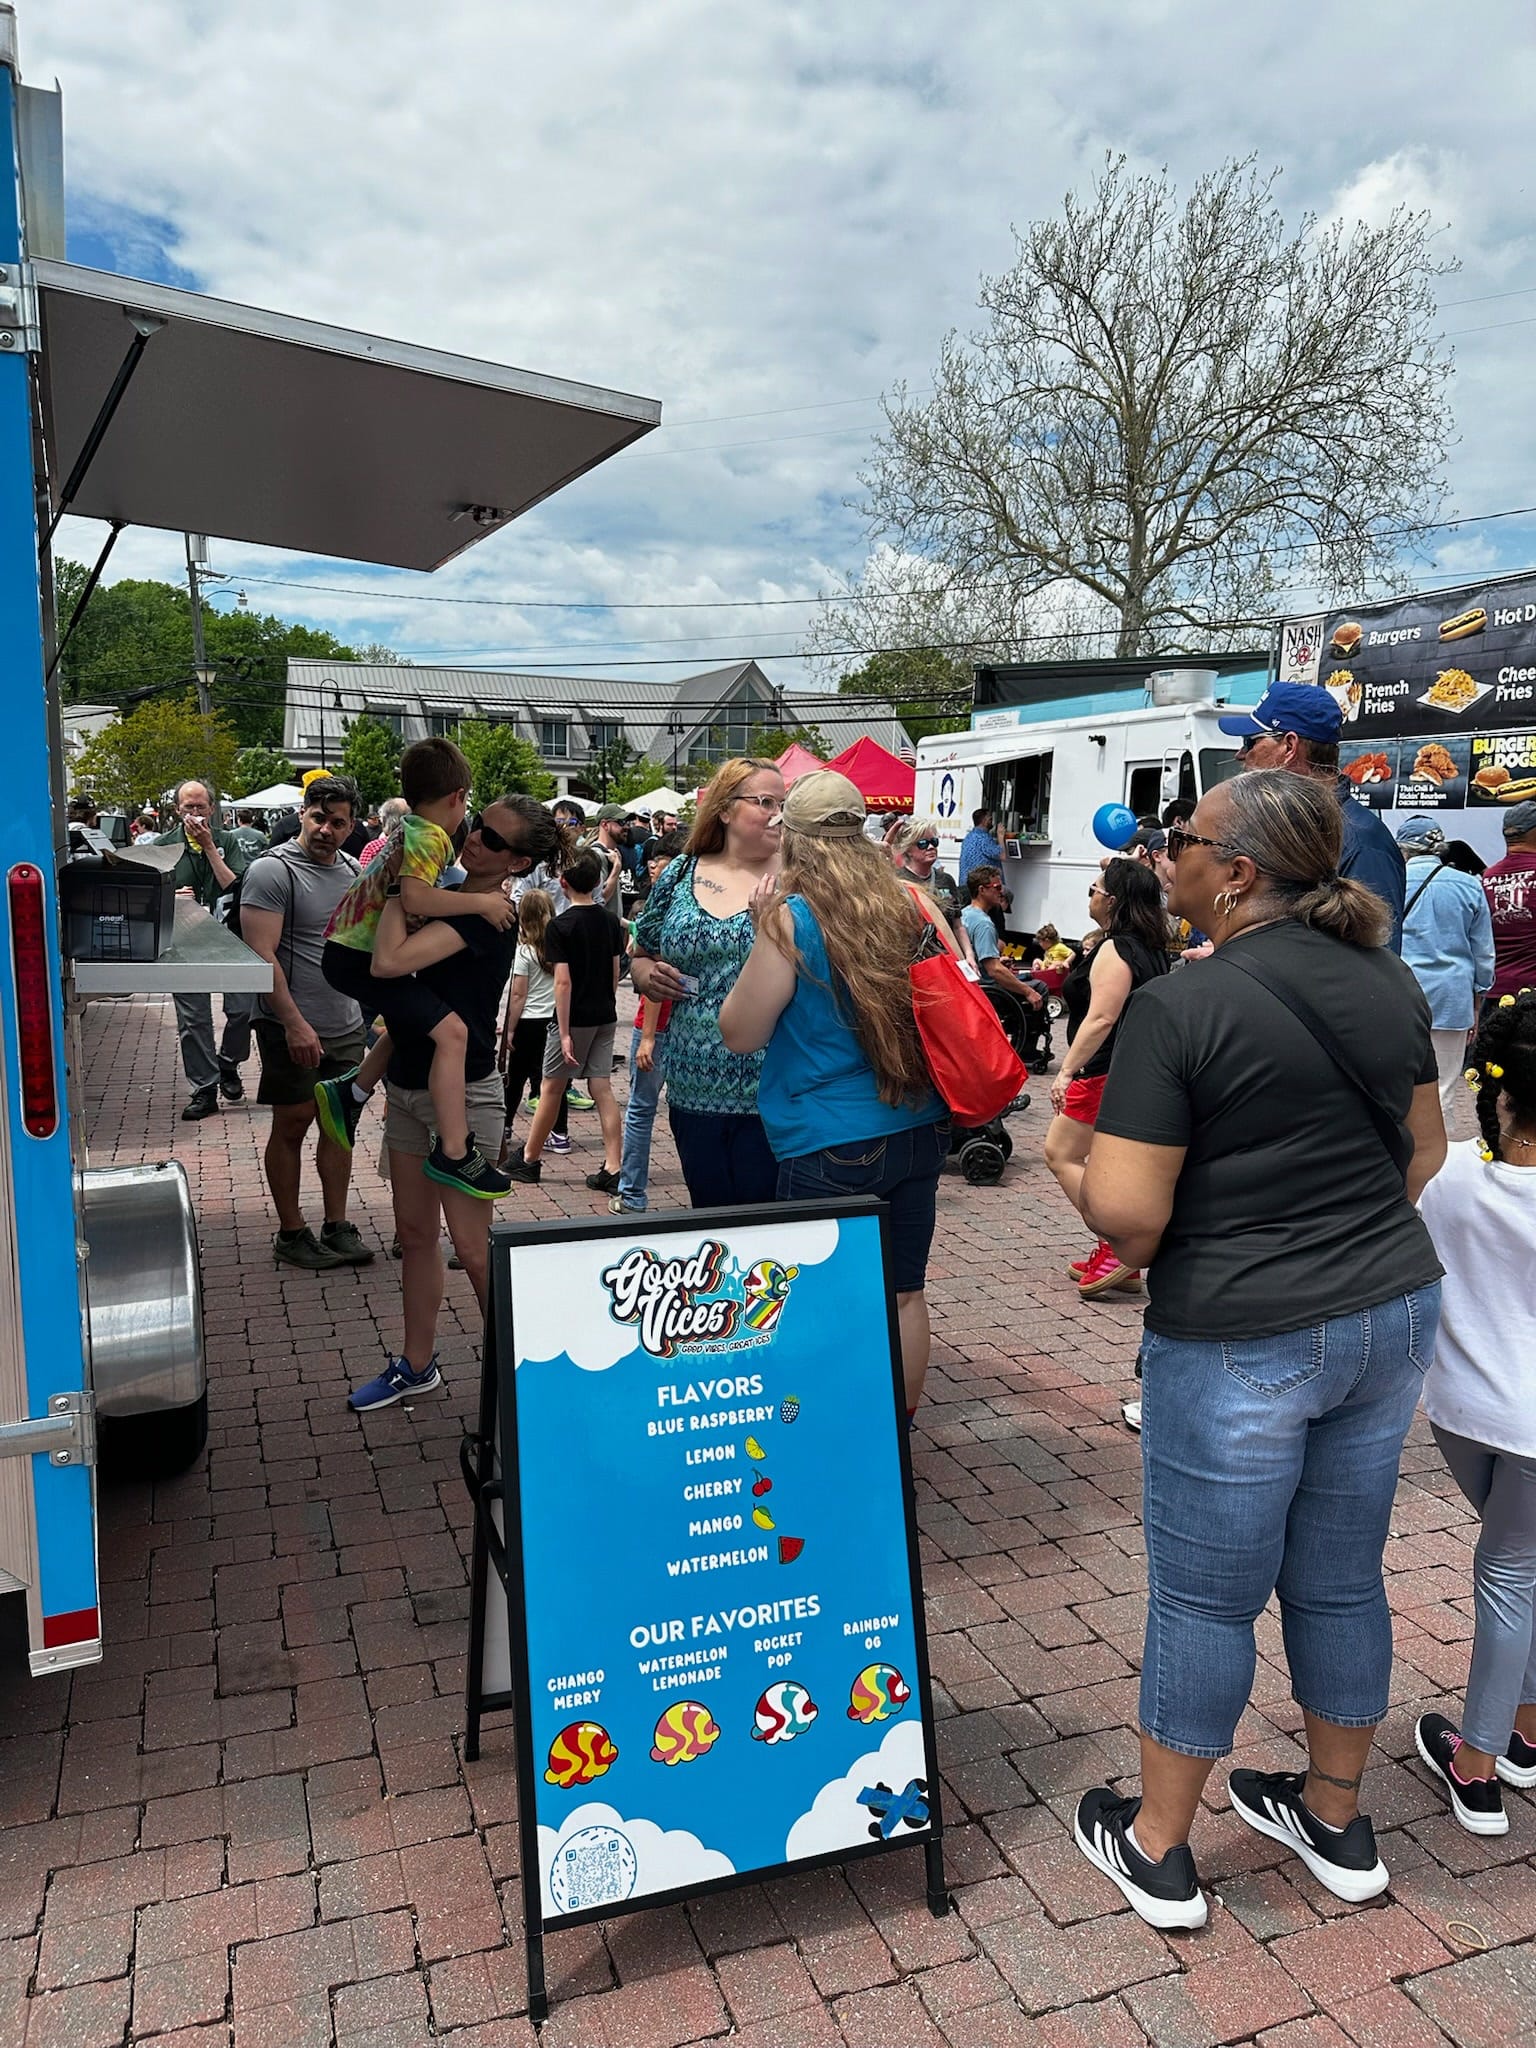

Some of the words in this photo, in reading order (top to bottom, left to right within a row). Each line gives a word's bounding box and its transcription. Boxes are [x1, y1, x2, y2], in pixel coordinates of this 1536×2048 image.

[1494, 608, 1522, 626] Hot
[1525, 604, 1536, 621] D
[1286, 624, 1321, 652] NASH
[1368, 627, 1421, 646] Burgers
[1498, 666, 1536, 684] Chee
[1365, 680, 1409, 698] French
[1496, 683, 1533, 702] Fries
[1365, 699, 1395, 714] Fries
[1483, 870, 1536, 887] SALUTE
[602, 1241, 722, 1320] Good
[637, 1288, 736, 1355] Vices
[681, 1344, 703, 1354] GOOD
[728, 1338, 754, 1351] GREAT
[755, 1334, 771, 1345] ICES
[657, 1374, 764, 1407] FLAVORS
[648, 1417, 684, 1437] BLUE
[690, 1405, 774, 1430] RASPBERRY
[686, 1444, 735, 1466] LEMON
[684, 1478, 742, 1501] CHERRY
[689, 1514, 743, 1537] MANGO
[667, 1546, 768, 1577] WATERMELON
[629, 1620, 685, 1648] OUR
[692, 1595, 821, 1638] FAVORITES
[843, 1614, 899, 1636] RAINBOW
[754, 1632, 803, 1653] ROCKET
[865, 1636, 881, 1650] OG
[639, 1646, 728, 1676] WATERMELON
[767, 1652, 792, 1669] POP
[547, 1669, 605, 1693] CHANGO
[652, 1665, 721, 1692] LEMONADE
[553, 1689, 601, 1711] MERRY
